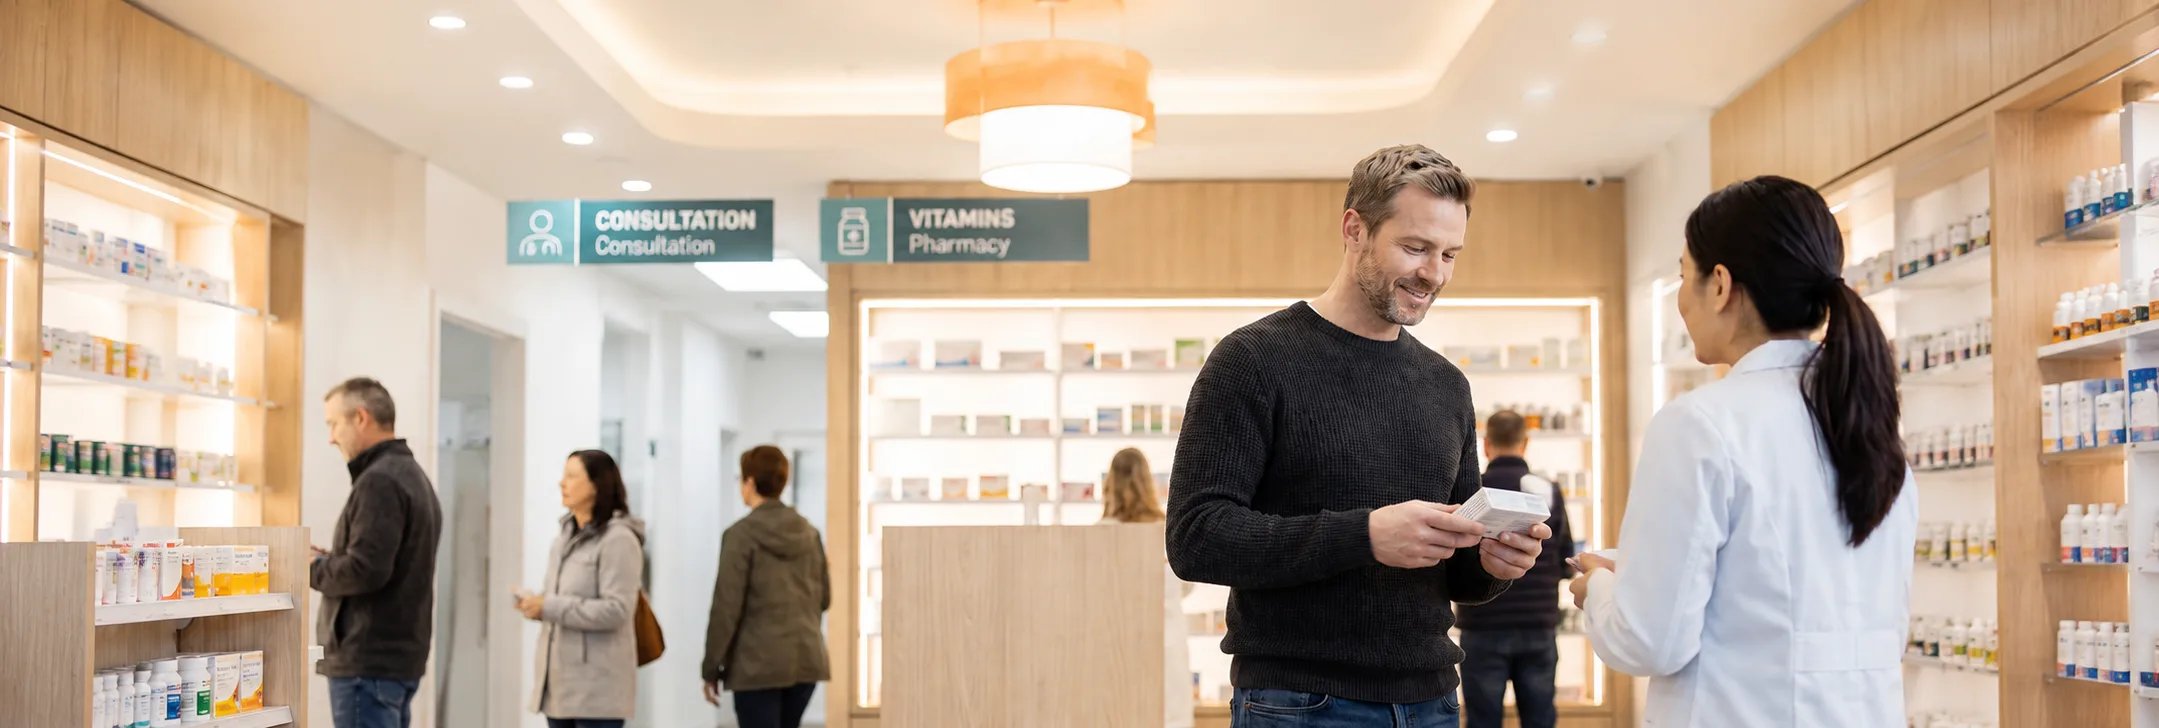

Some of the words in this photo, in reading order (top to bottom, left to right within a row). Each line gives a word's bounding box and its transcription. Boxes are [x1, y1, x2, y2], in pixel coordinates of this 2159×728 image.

[595, 209, 757, 231] CONSULTATION
[909, 208, 1015, 229] VITAMINS
[595, 234, 715, 256] Consultation
[909, 234, 1010, 257] Pharmacy
